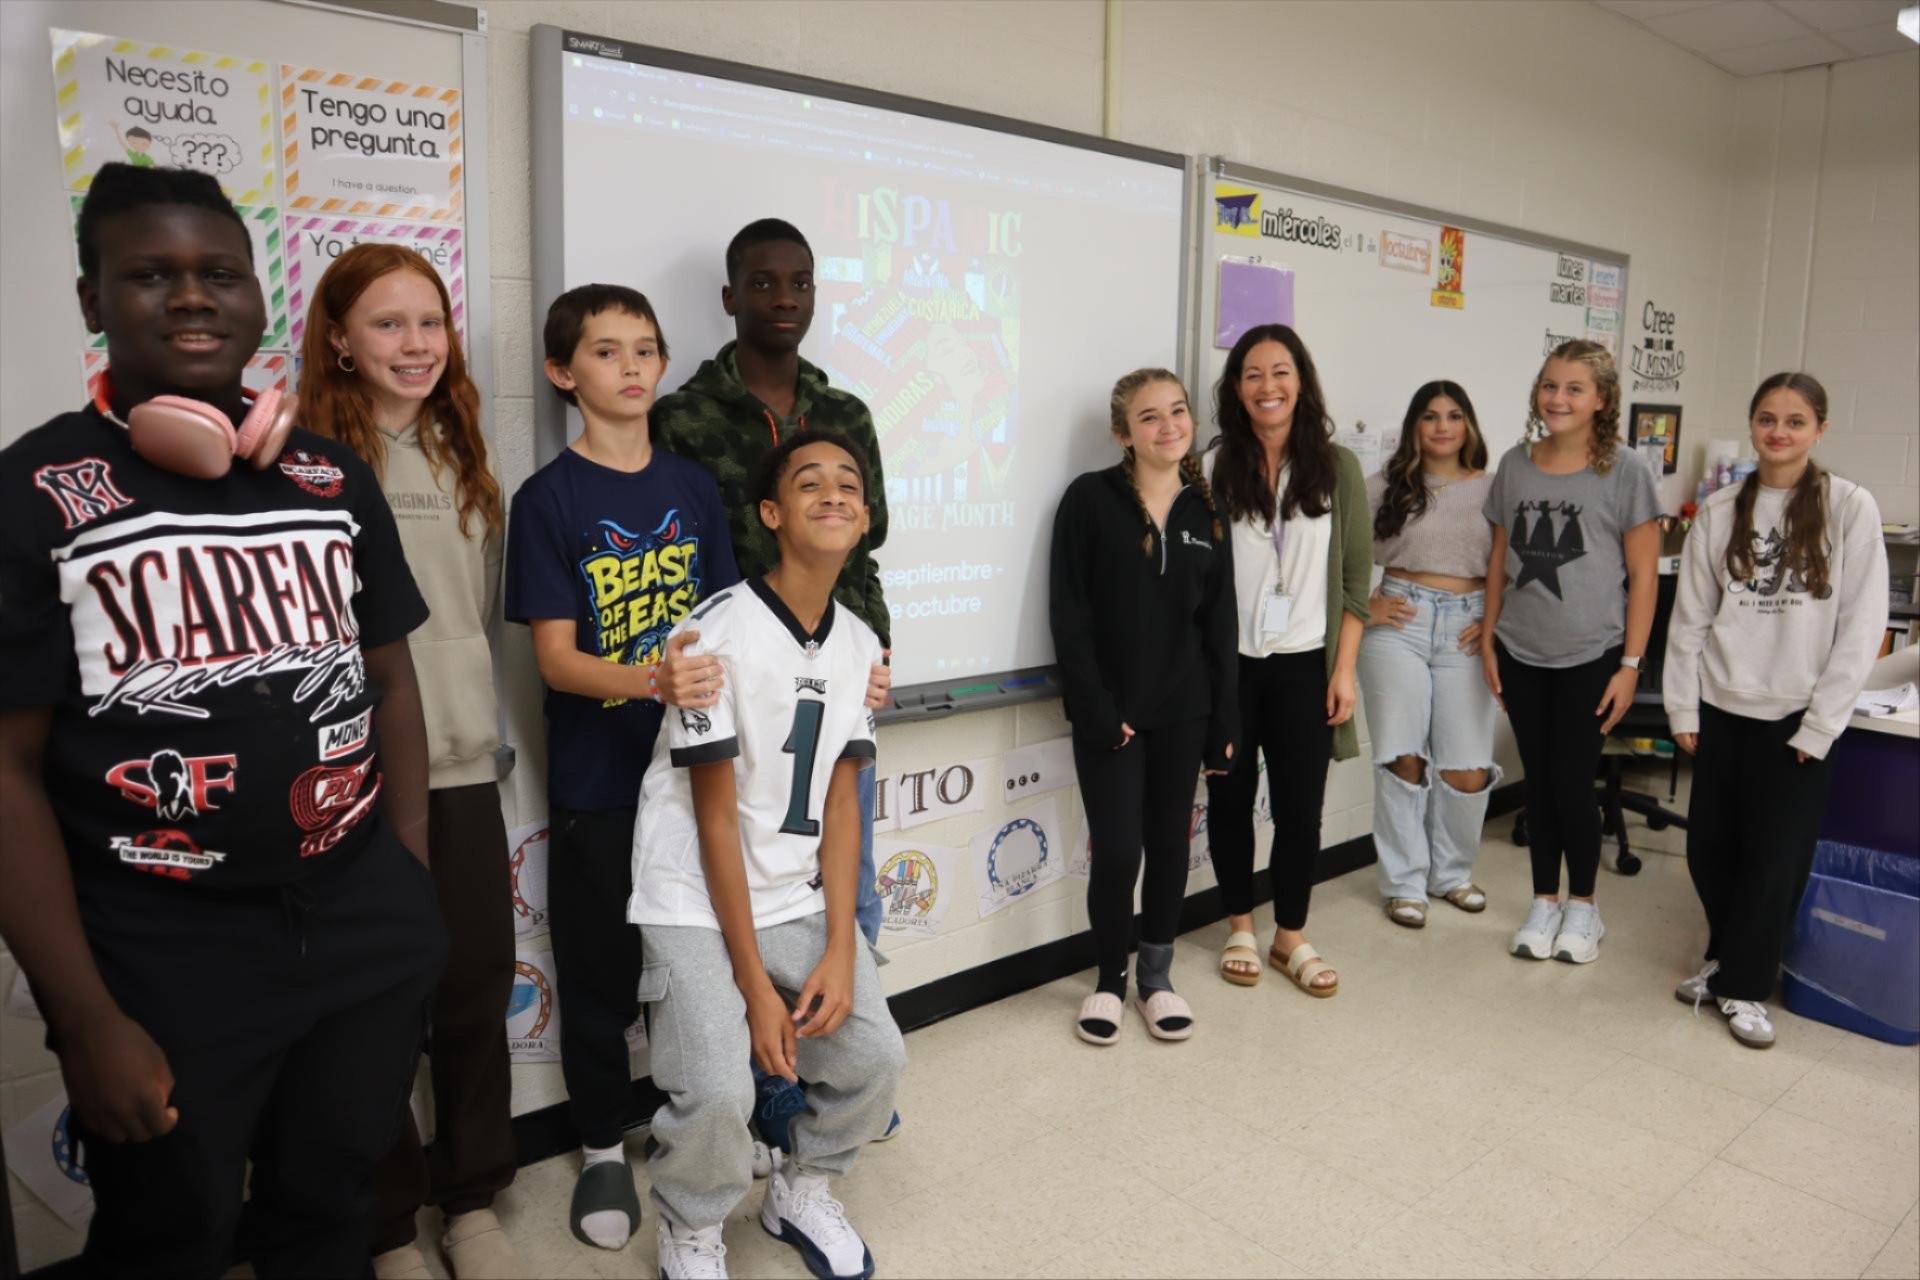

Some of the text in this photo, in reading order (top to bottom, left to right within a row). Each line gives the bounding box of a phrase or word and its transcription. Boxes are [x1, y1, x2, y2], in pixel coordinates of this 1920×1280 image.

[105, 56, 229, 97] Necesito
[301, 88, 446, 130] Tengo una
[310, 126, 440, 159] pregunta.
[337, 178, 363, 190] have
[365, 182, 373, 191] a
[820, 176, 1023, 257] HISPANIC
[309, 232, 343, 258] Ya
[1550, 282, 1585, 306] martes
[1642, 300, 1675, 334] Cree
[1632, 344, 1685, 376] TI MISMO
[385, 493, 451, 510] RIGINALS
[942, 500, 1015, 530] MONTH
[585, 546, 697, 605] BEAST
[882, 561, 993, 590] septiembre
[86, 540, 355, 676] SCARFAC
[600, 602, 625, 628] OF
[907, 595, 982, 618] octubre
[600, 623, 627, 649] THE
[777, 699, 825, 836] 1
[873, 765, 974, 821] ITO
[122, 850, 137, 860] THE
[140, 852, 168, 861] WORLD
